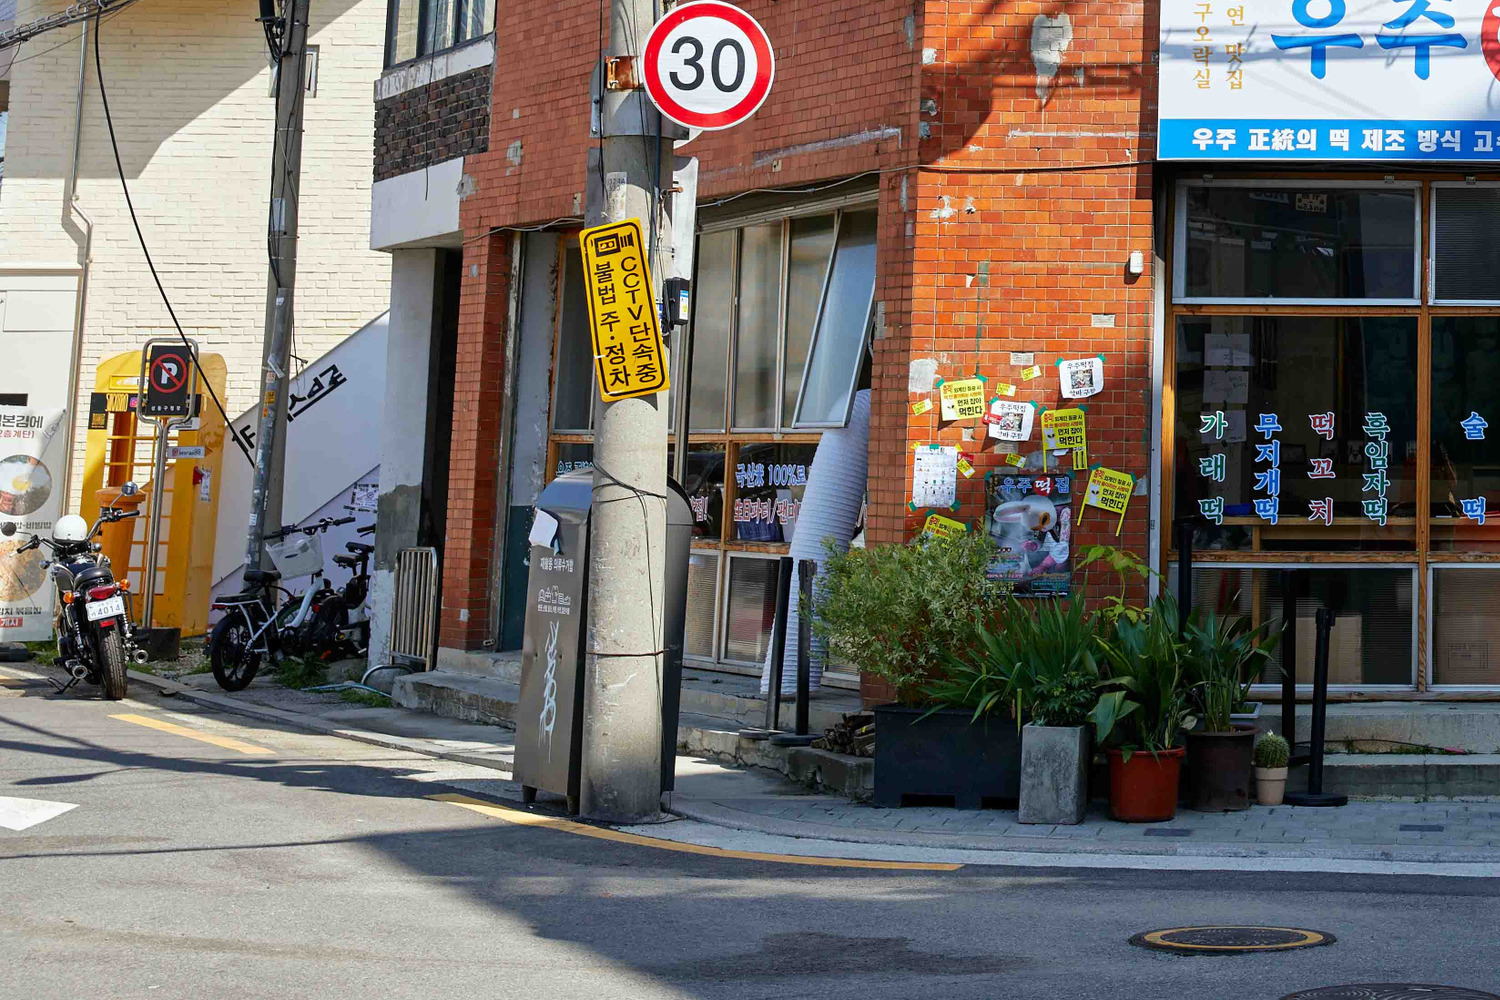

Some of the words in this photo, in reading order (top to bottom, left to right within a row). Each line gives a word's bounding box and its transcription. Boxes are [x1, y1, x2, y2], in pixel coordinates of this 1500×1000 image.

[669, 36, 746, 93] 30
[1225, 44, 1246, 91] 맛집
[1192, 128, 1237, 151] 우주
[1248, 128, 1317, 151] 正統의
[1329, 128, 1350, 150] 떡
[1361, 128, 1406, 151] 제조
[1417, 128, 1462, 152] 방식
[594, 261, 617, 306] 불법
[600, 310, 631, 387] 주·정차
[735, 462, 765, 488] 국산米
[1198, 410, 1228, 525] 가래떡
[1252, 412, 1283, 525] 무지개떡
[1307, 411, 1336, 526] 떡꼬치
[1361, 411, 1391, 526] 흑임자떡
[1460, 411, 1489, 526] 술떡
[734, 498, 801, 524] 生日파티/팬미
[97, 603, 121, 616] 4014
